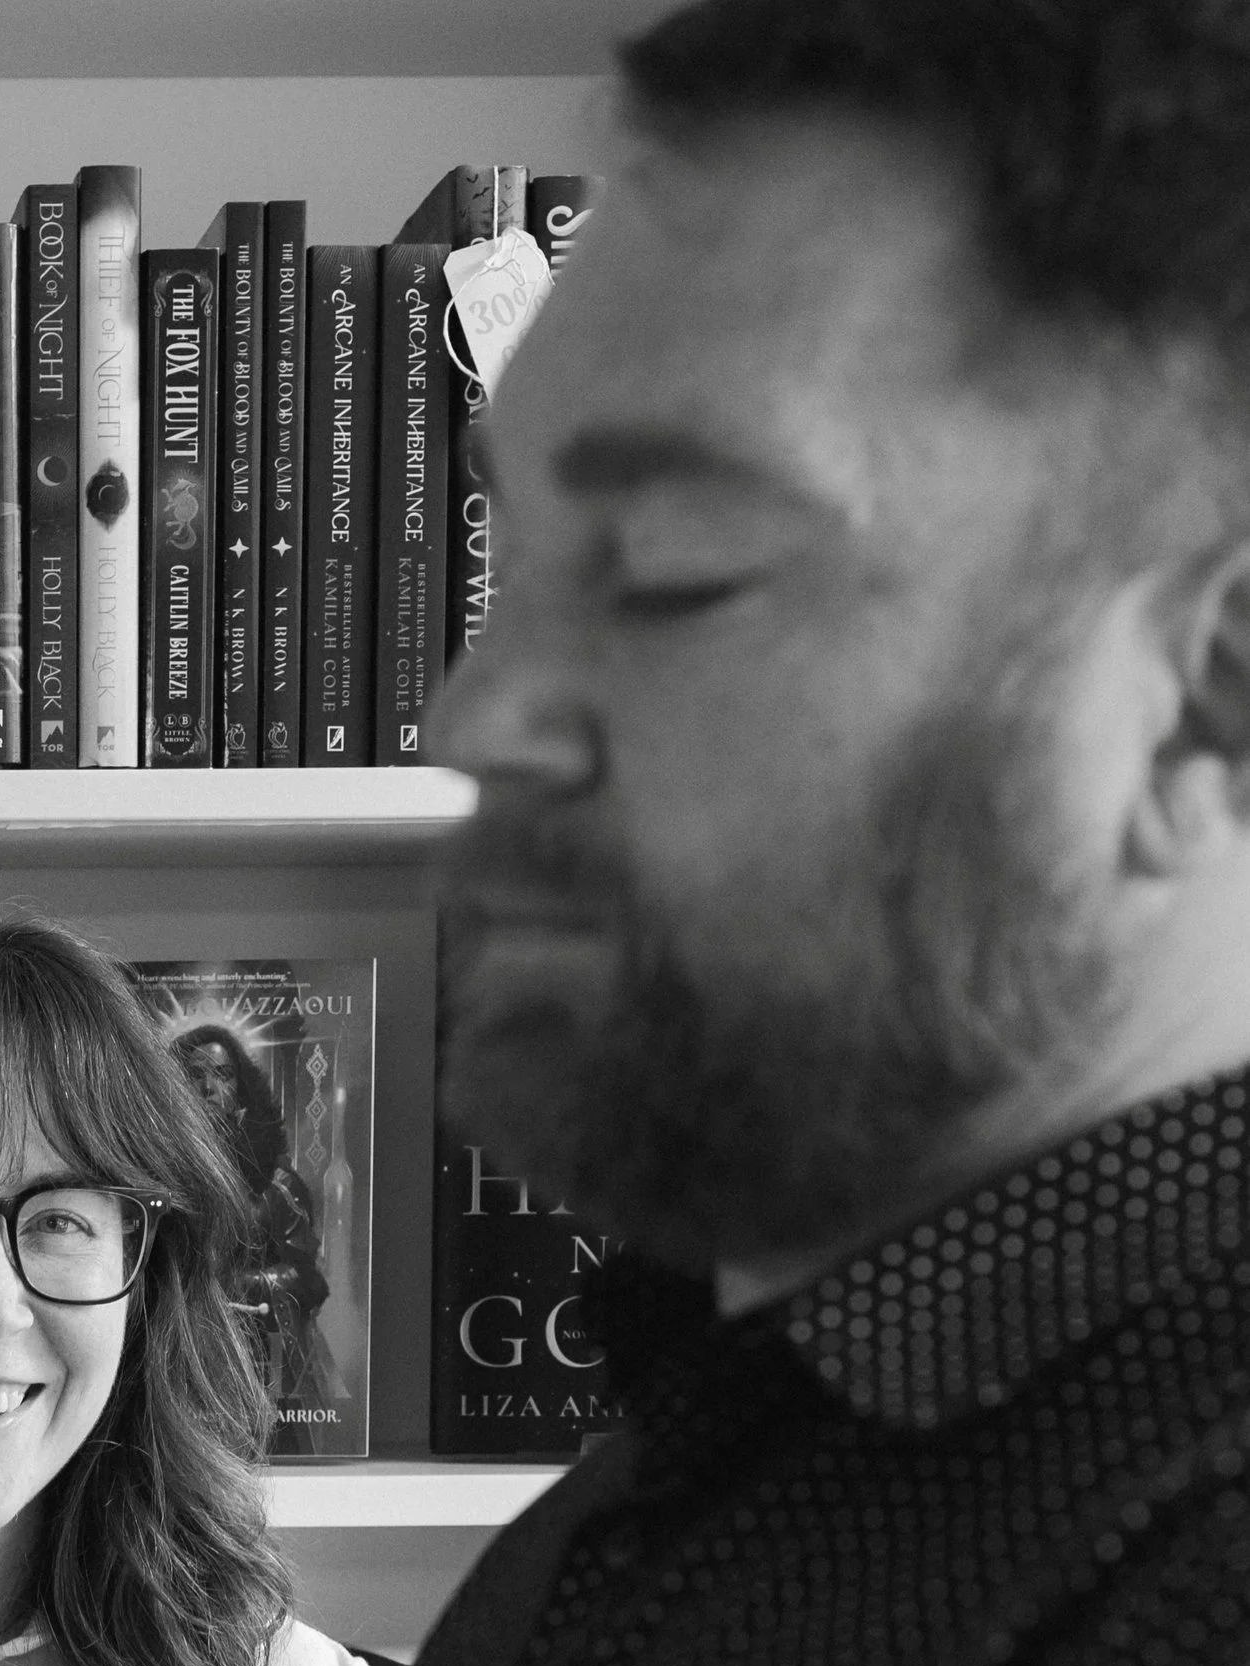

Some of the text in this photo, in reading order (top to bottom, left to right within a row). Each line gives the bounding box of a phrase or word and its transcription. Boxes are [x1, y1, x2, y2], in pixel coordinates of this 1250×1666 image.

[33, 202, 68, 400] BOOK OF NIGHT
[93, 224, 126, 447] THIEF OF NIGHT
[164, 285, 200, 463] THE FOX HUNT
[274, 242, 295, 512] THE BOUNTY OF BLOOD AND NAILS
[230, 244, 251, 513] THE BOUNTY OF BLOOD AND NAILS
[331, 264, 356, 543] AN ARCANE INHERITANCE
[405, 263, 430, 542] AN ARCANE INHERITANCE
[37, 557, 62, 710] HOLLY BLACK
[92, 547, 116, 699] HOLLY BLACK
[168, 565, 189, 699] CAITLIN BREEZE
[231, 627, 245, 693] BROWN
[274, 626, 287, 692] BROWN
[322, 558, 338, 712] KAMILAH COLE
[341, 564, 352, 707] BESTSELLING AUTHOR
[396, 557, 412, 711] KAMILAH COLE
[415, 563, 426, 707] BESTSELLING AUTHOR
[41, 744, 64, 753] TOR
[201, 972, 216, 982] and
[217, 972, 242, 982] utterly
[461, 1395, 542, 1417] LIZA
